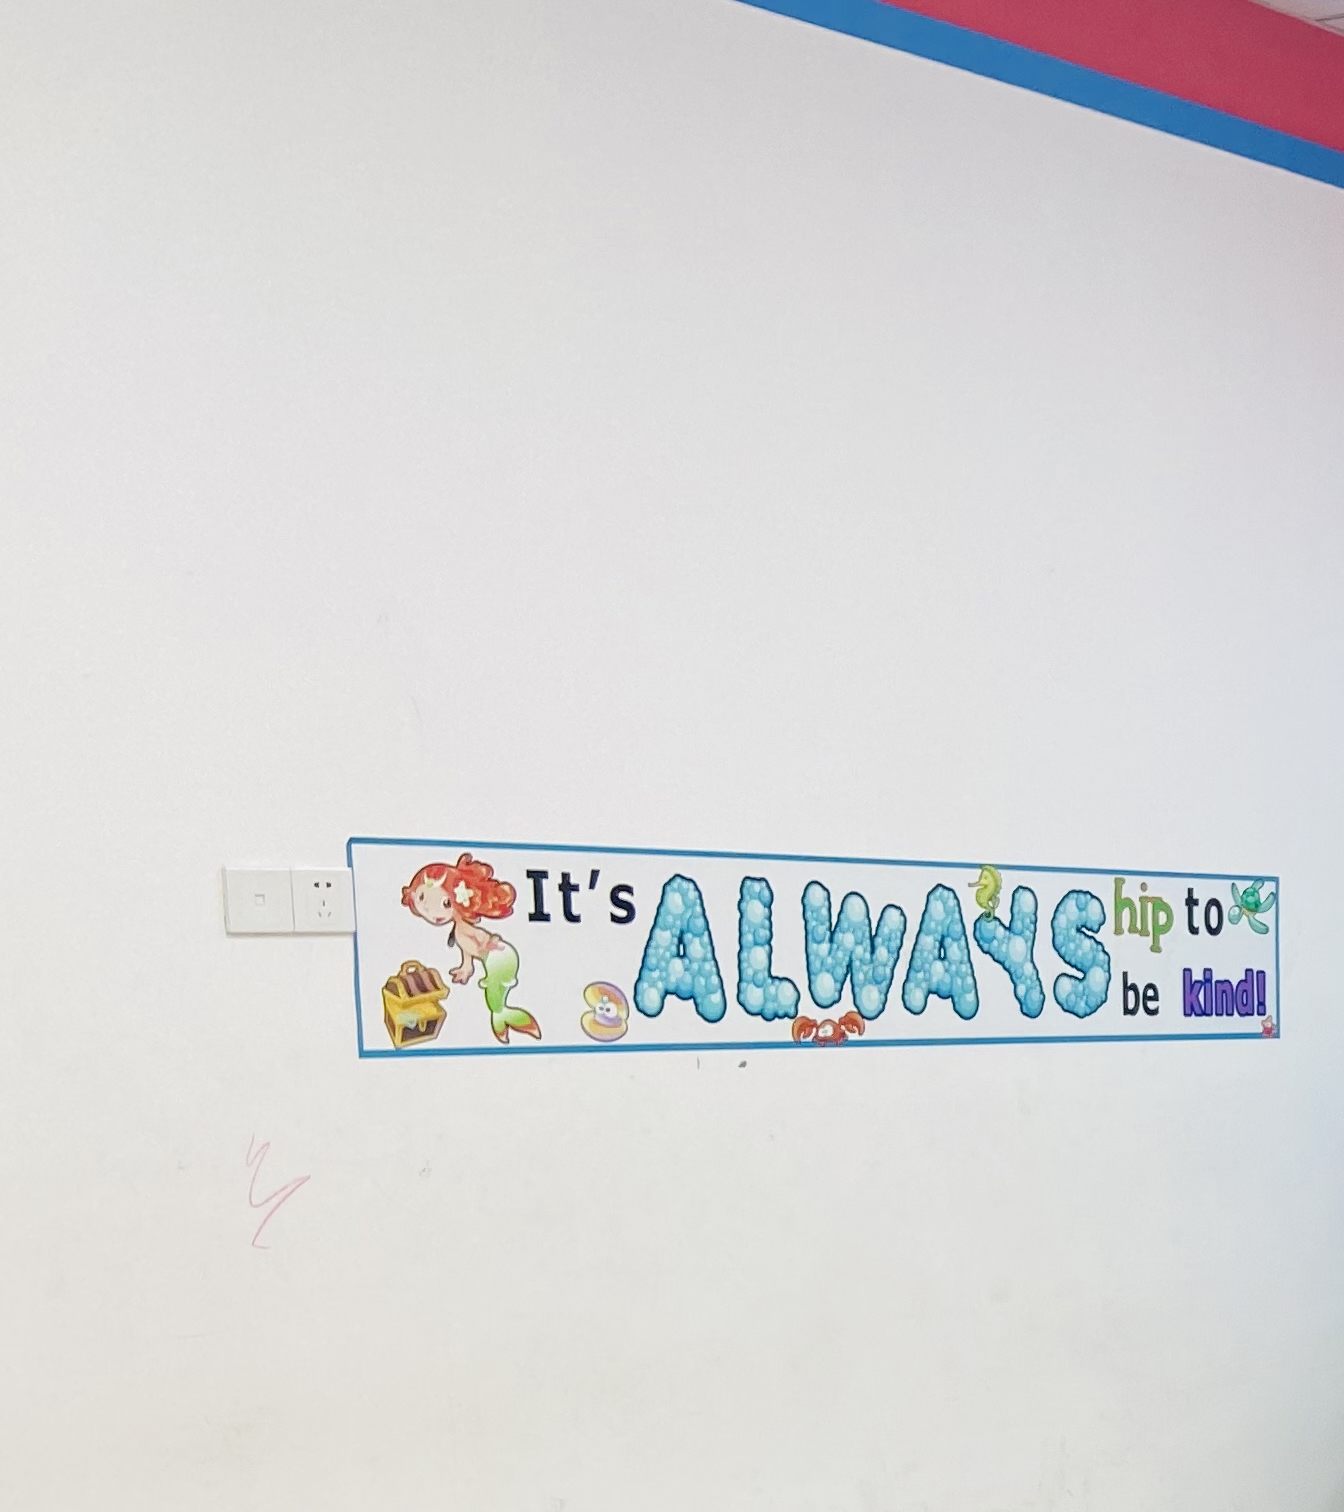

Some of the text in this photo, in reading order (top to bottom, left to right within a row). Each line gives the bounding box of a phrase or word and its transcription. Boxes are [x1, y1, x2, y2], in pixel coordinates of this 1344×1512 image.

[526, 868, 1224, 1022] It's ALWAYS hip to
[1122, 967, 1267, 1018] be kind!
